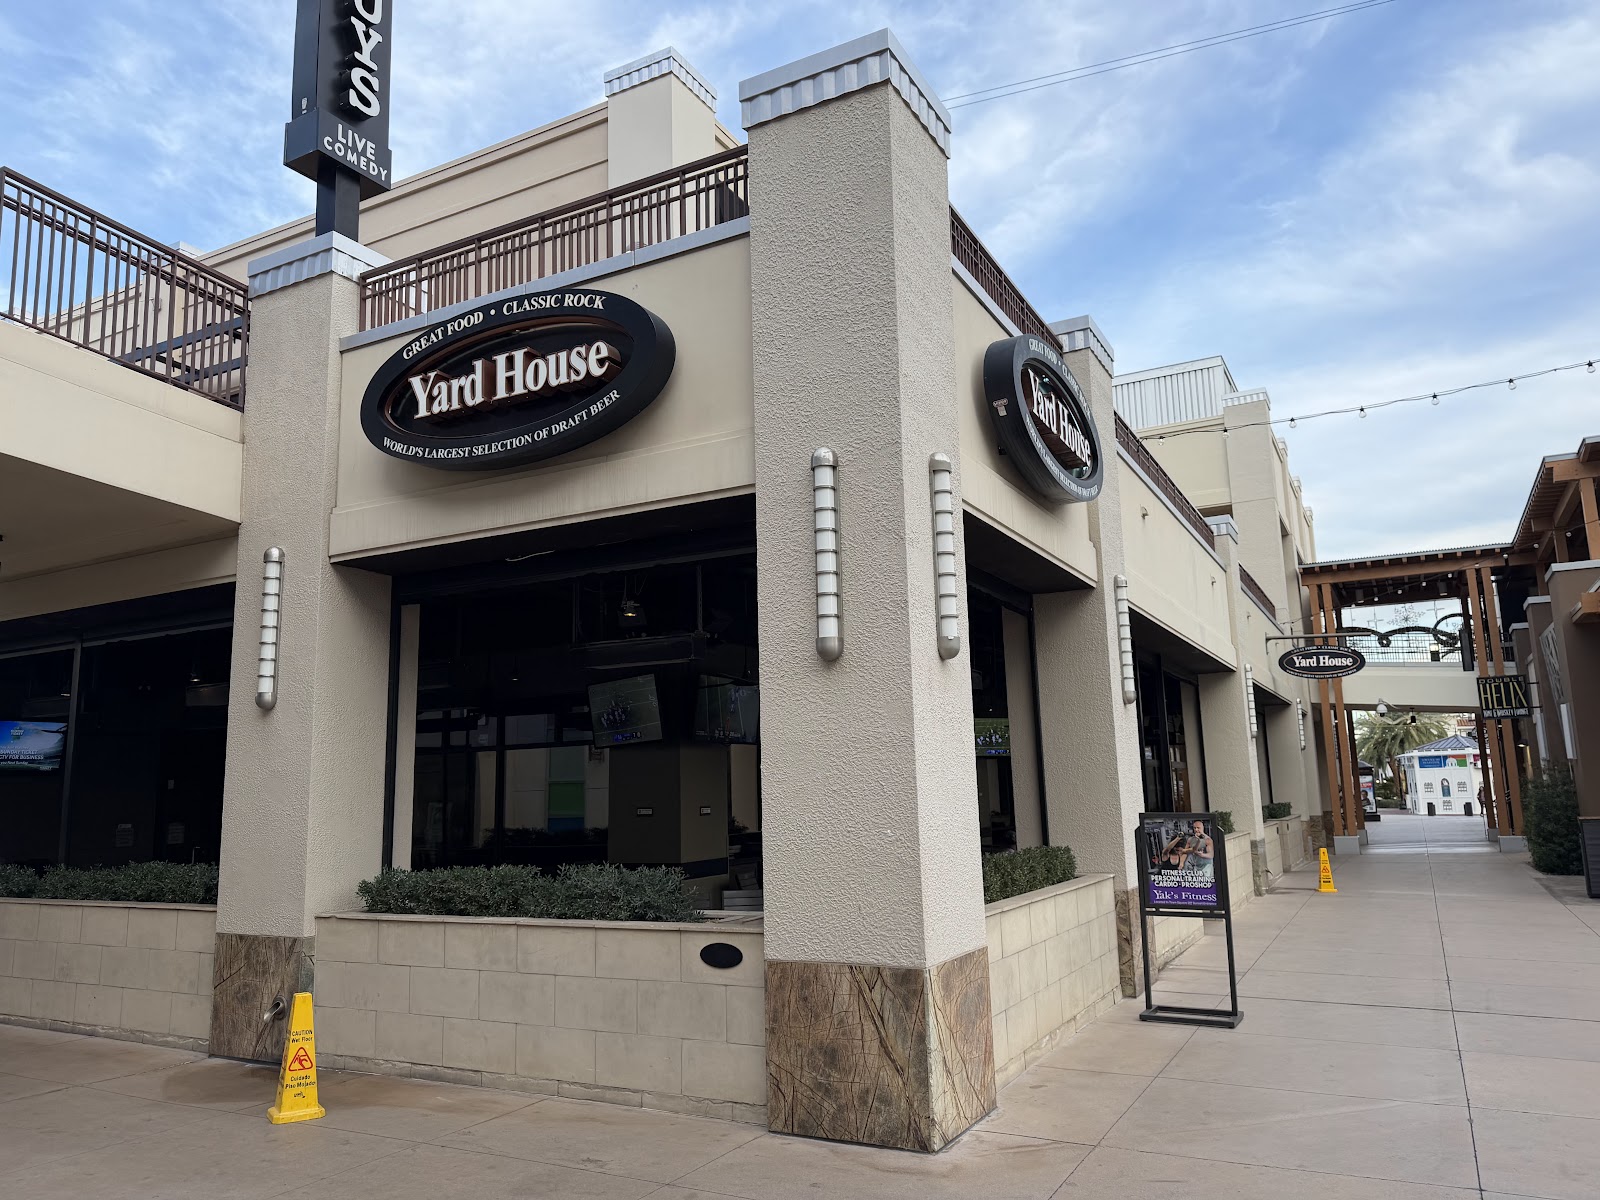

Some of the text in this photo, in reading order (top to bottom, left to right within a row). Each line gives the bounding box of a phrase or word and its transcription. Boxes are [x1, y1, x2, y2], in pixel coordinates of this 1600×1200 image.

[337, 123, 376, 161] LIVE
[323, 136, 388, 181] COMEDY
[402, 293, 607, 360] GREAT FOOD CLASSIC ROCK
[407, 340, 611, 420] Yard House
[383, 389, 621, 459] WORLD'S LARGEST SELECTION OF DRAFT BEER
[1028, 368, 1092, 468] Yard House
[1292, 655, 1353, 667] Yard House
[1478, 676, 1524, 684] DOUBLE
[1480, 681, 1528, 710] HELIX
[1153, 889, 1217, 902] Yak's Fitness
[291, 1029, 313, 1037] CAUTION
[290, 1074, 311, 1082] Cuidado
[297, 1080, 316, 1089] Mojado
